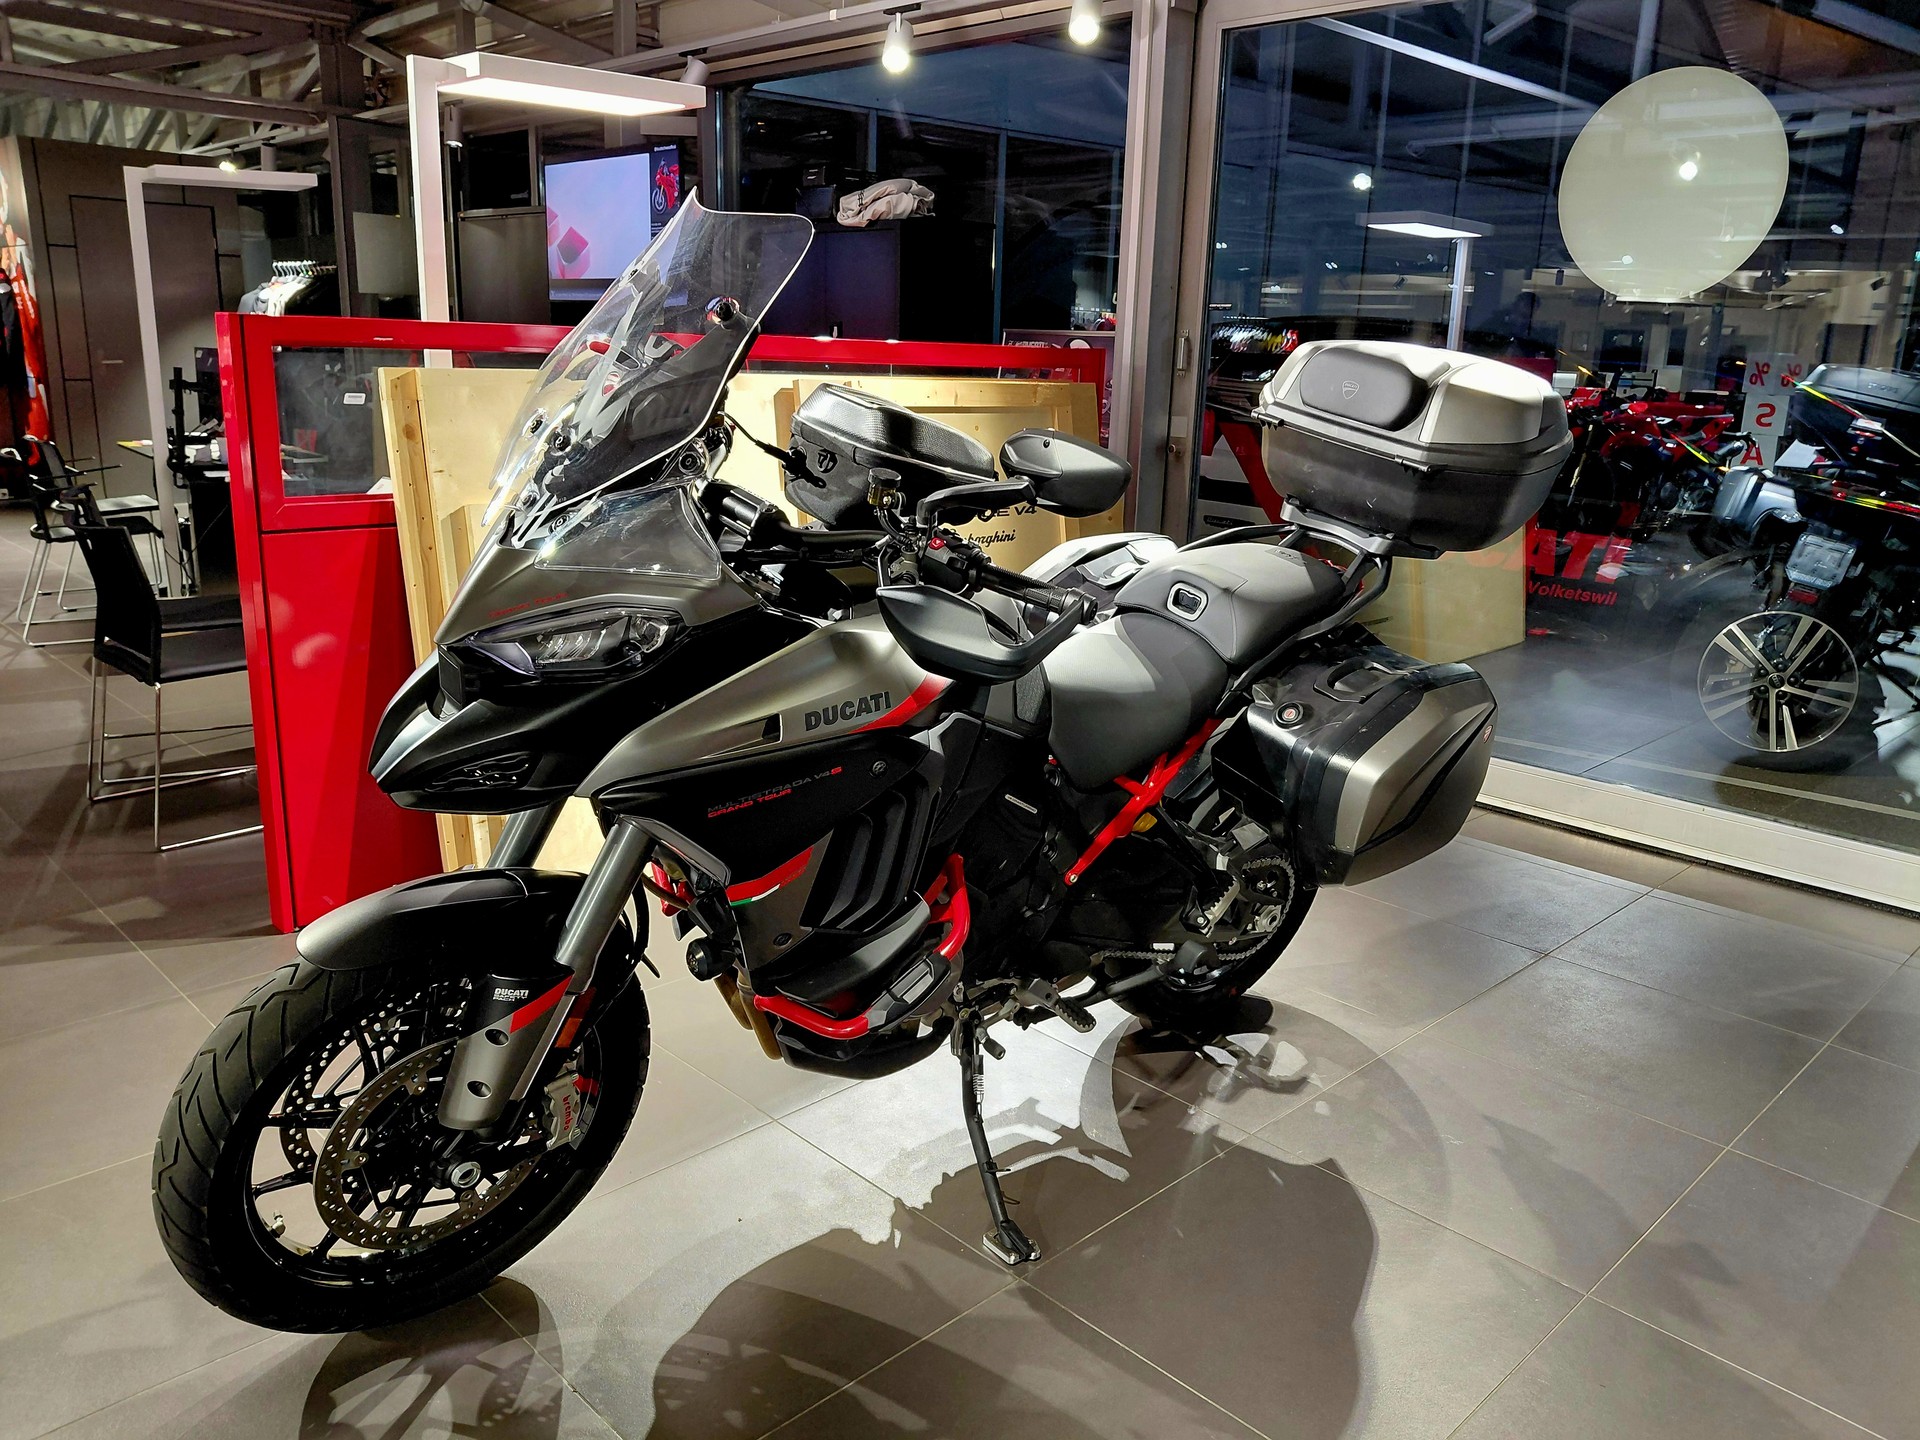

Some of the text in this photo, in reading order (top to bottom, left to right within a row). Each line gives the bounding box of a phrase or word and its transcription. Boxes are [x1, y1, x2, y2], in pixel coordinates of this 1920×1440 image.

[1528, 580, 1618, 606] Volketswil
[805, 691, 892, 731] DUCATI
[708, 777, 812, 813] MULTISTRADA
[708, 788, 792, 818] GRAND TOUR
[494, 988, 529, 997] DUCATI
[563, 1094, 573, 1131] brembo
